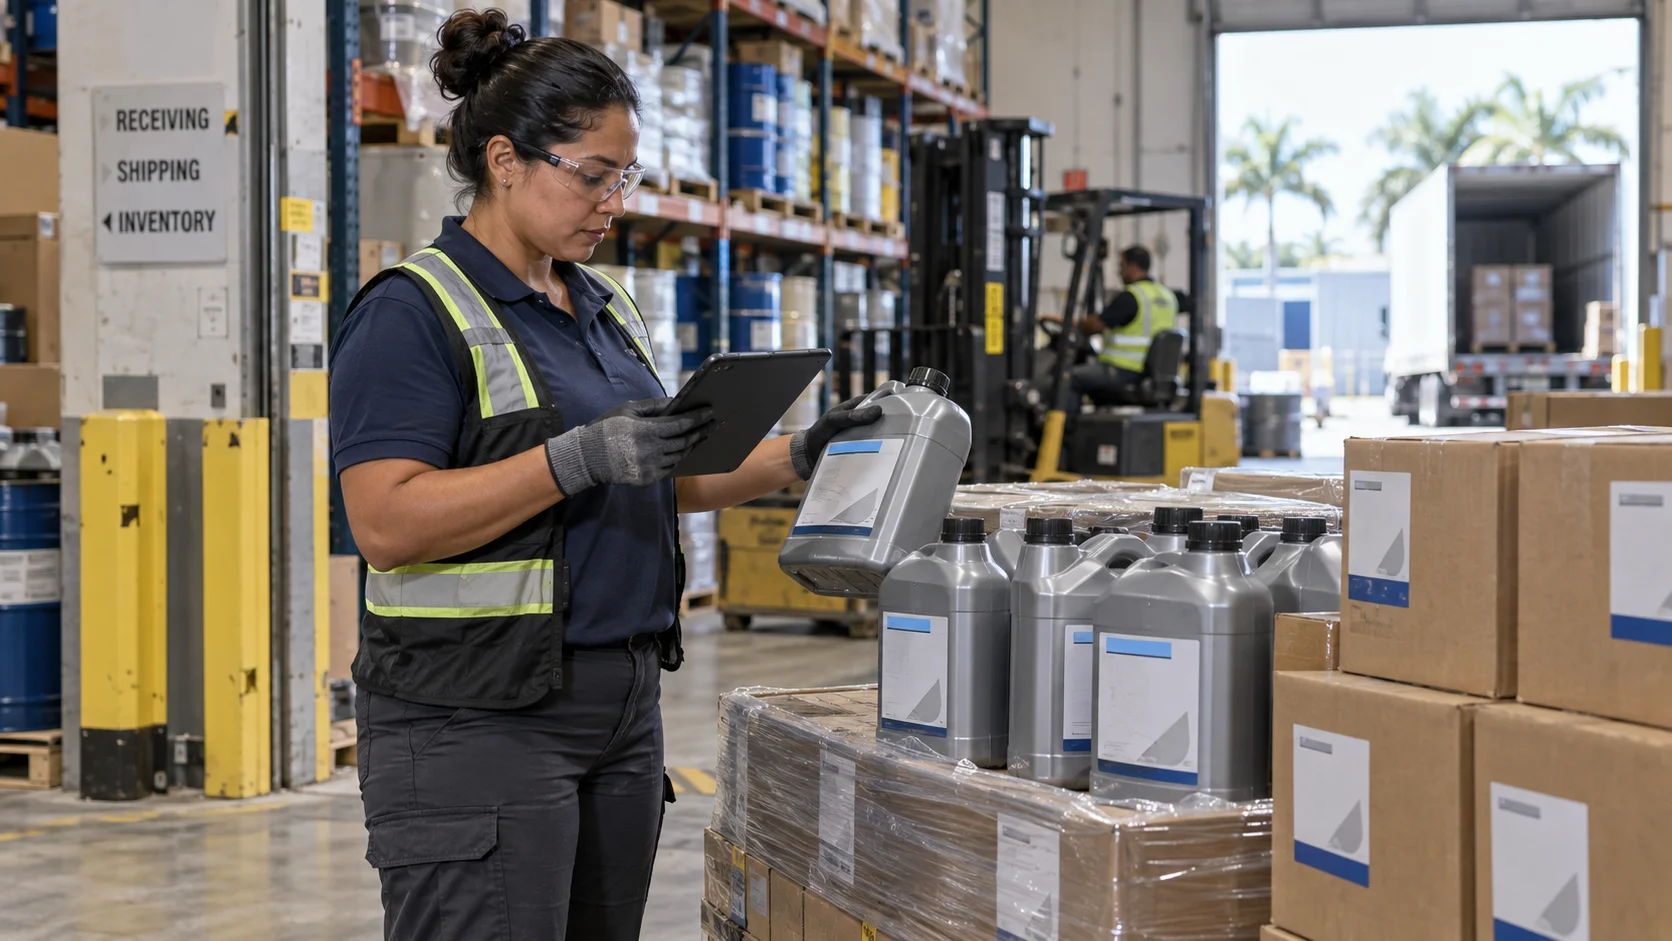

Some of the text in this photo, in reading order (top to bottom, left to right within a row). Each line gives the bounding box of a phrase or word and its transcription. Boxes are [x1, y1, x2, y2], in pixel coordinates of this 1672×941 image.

[117, 108, 209, 131] RECEIVING
[117, 159, 200, 182] SHIPPING
[118, 210, 216, 232] INVENTORY
